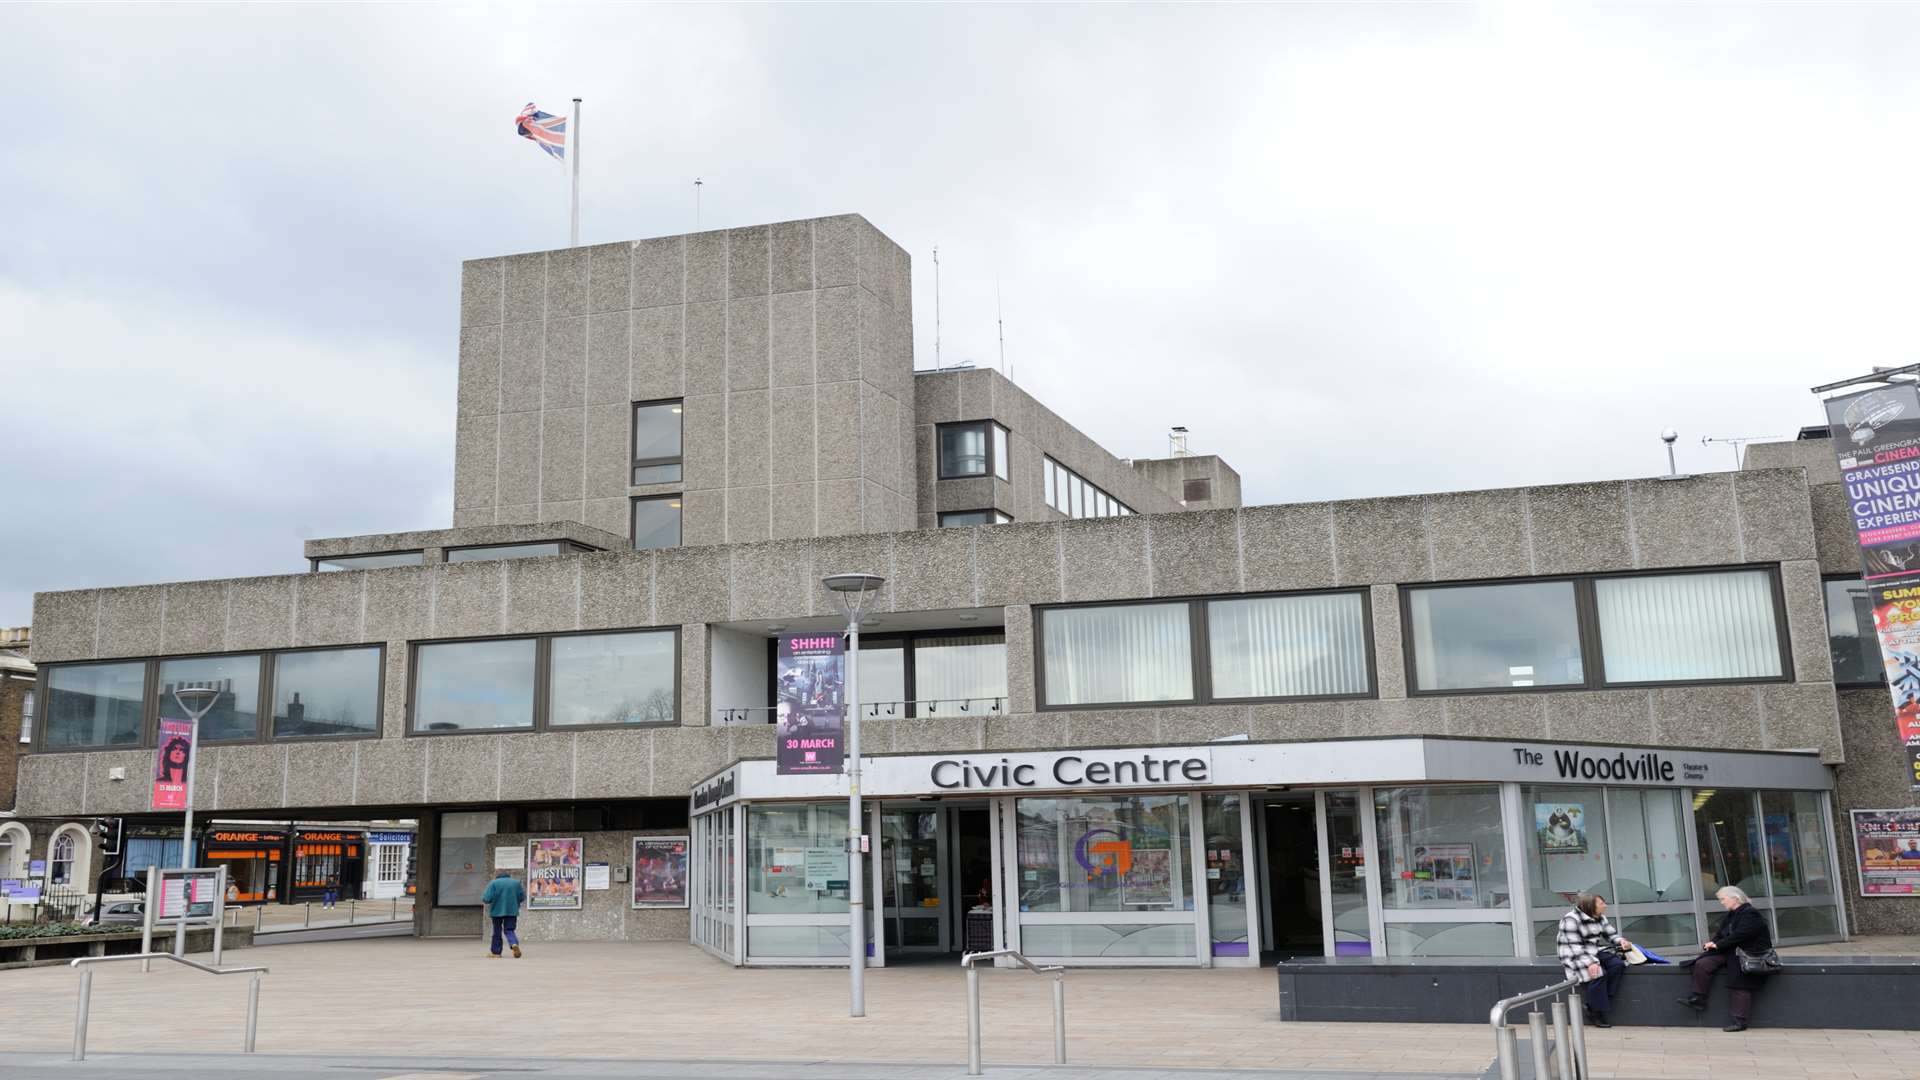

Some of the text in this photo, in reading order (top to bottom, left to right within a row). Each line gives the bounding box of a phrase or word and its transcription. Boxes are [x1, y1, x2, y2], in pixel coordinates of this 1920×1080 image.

[790, 637, 834, 650] SHHH!
[786, 738, 835, 749] 30 MARCH
[931, 754, 1208, 789] Civic Centre
[1514, 748, 1543, 766] The
[1555, 750, 1675, 782] Woodville
[215, 832, 259, 842] ORANGE
[304, 832, 342, 841] ORANGE
[532, 866, 579, 880] WRESTLING
